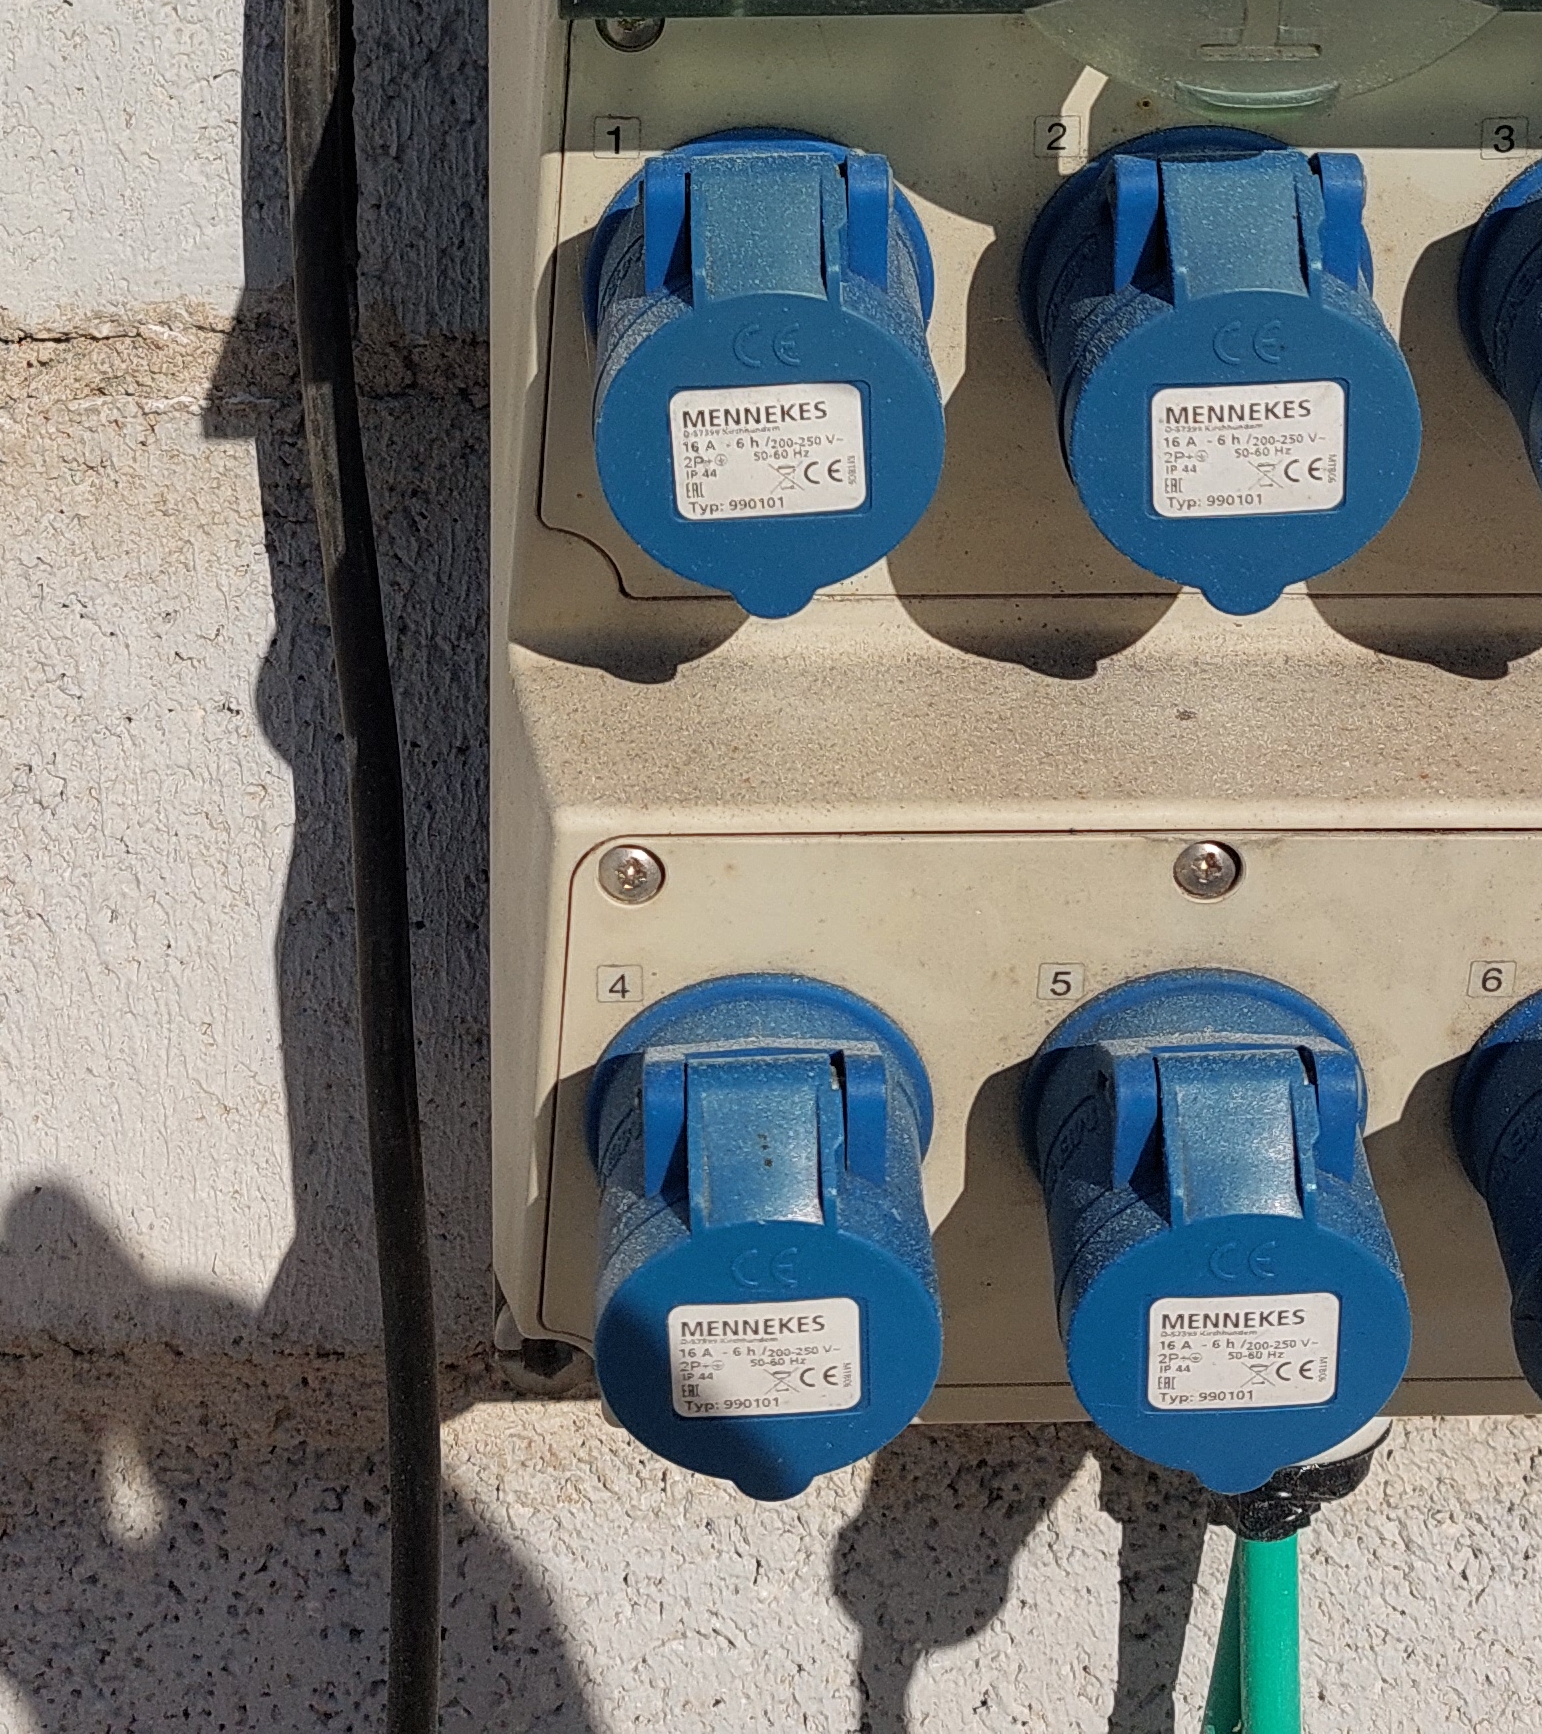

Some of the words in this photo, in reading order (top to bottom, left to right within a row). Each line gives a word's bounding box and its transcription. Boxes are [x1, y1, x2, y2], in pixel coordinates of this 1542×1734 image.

[607, 126, 621, 154] 1
[1047, 122, 1067, 150] 2
[1493, 125, 1515, 152] 3
[683, 401, 827, 428] MENNEKES
[1165, 399, 1311, 424] MENNEKES
[683, 441, 699, 453] 16
[706, 440, 716, 451] A
[736, 438, 744, 448] 6
[750, 437, 759, 448] h
[1164, 438, 1180, 447] 16
[1186, 437, 1197, 447] A
[1217, 435, 1225, 445] 6
[1232, 434, 1240, 445] h
[754, 451, 788, 461] 50-60
[794, 449, 810, 458] Hz
[1235, 448, 1270, 458] 50-60
[1275, 447, 1292, 456] Hz
[687, 470, 697, 479] IP
[702, 469, 717, 478] 44
[804, 460, 843, 484] CE
[1166, 466, 1176, 474] IP
[1182, 465, 1196, 473] 44
[1284, 458, 1323, 482] CE
[689, 501, 724, 514] Typ:
[729, 497, 784, 510] 990101
[1167, 497, 1201, 510] Typ:
[1207, 494, 1262, 506] 990101
[609, 975, 629, 997] 4
[1050, 972, 1071, 996] 5
[1481, 969, 1503, 993] 6
[681, 1315, 825, 1337] MENNEKES
[1162, 1309, 1305, 1329] MENNEKES
[680, 1349, 696, 1358] 16
[702, 1348, 713, 1356] A
[748, 1347, 756, 1356] h
[1160, 1341, 1175, 1350] 16
[1181, 1341, 1192, 1349] A
[1213, 1340, 1221, 1349] 6
[1226, 1339, 1235, 1348] h
[800, 1366, 838, 1387] CE
[1276, 1360, 1314, 1381] CE
[685, 1401, 719, 1412] Typ:
[724, 1398, 780, 1409] 990101
[1160, 1393, 1193, 1404] Typ:
[1199, 1391, 1253, 1401] 990101
